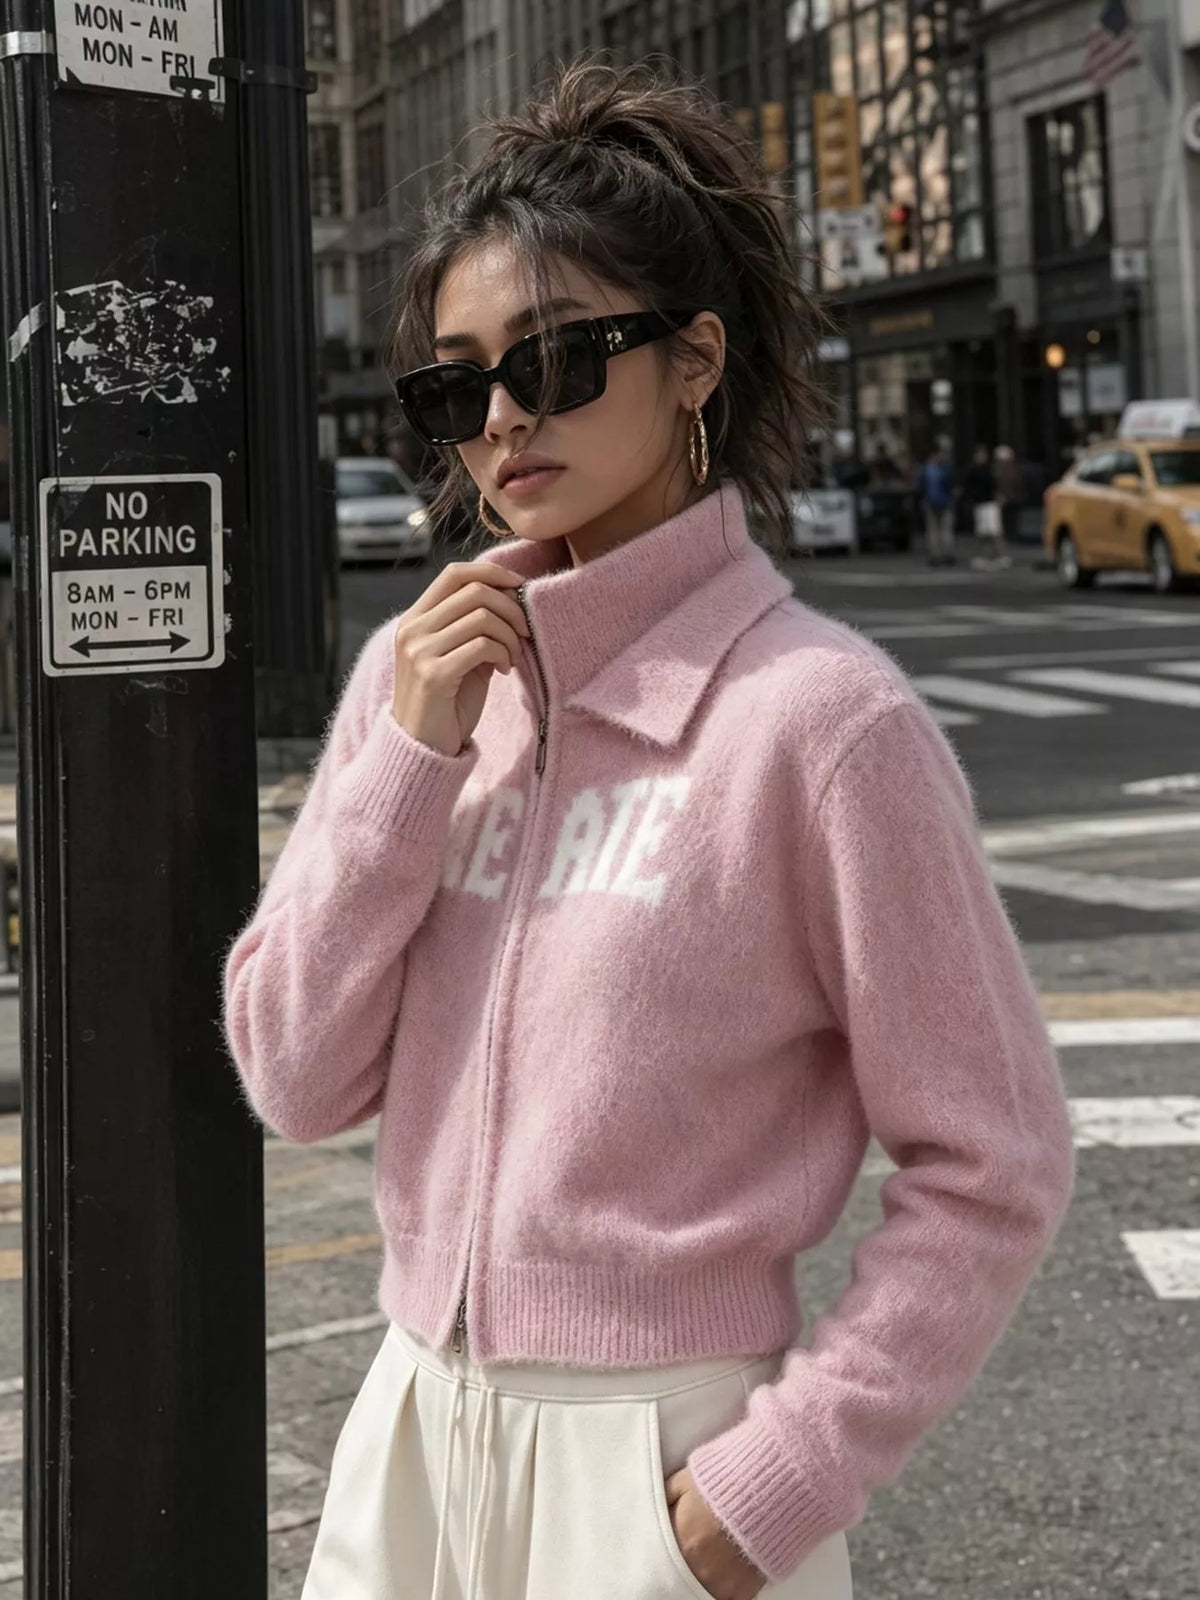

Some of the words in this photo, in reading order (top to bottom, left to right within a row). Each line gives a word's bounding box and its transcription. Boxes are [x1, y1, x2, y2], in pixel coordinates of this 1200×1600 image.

[74, 3, 124, 33] MON
[148, 15, 179, 43] AM
[82, 37, 133, 68] MON
[161, 51, 195, 78] FRI
[106, 491, 148, 520] NO
[59, 525, 196, 557] PARKING
[67, 582, 115, 604] 8AM
[144, 580, 191, 600] 6PM
[71, 611, 118, 631] MON
[149, 608, 183, 627] FRI
